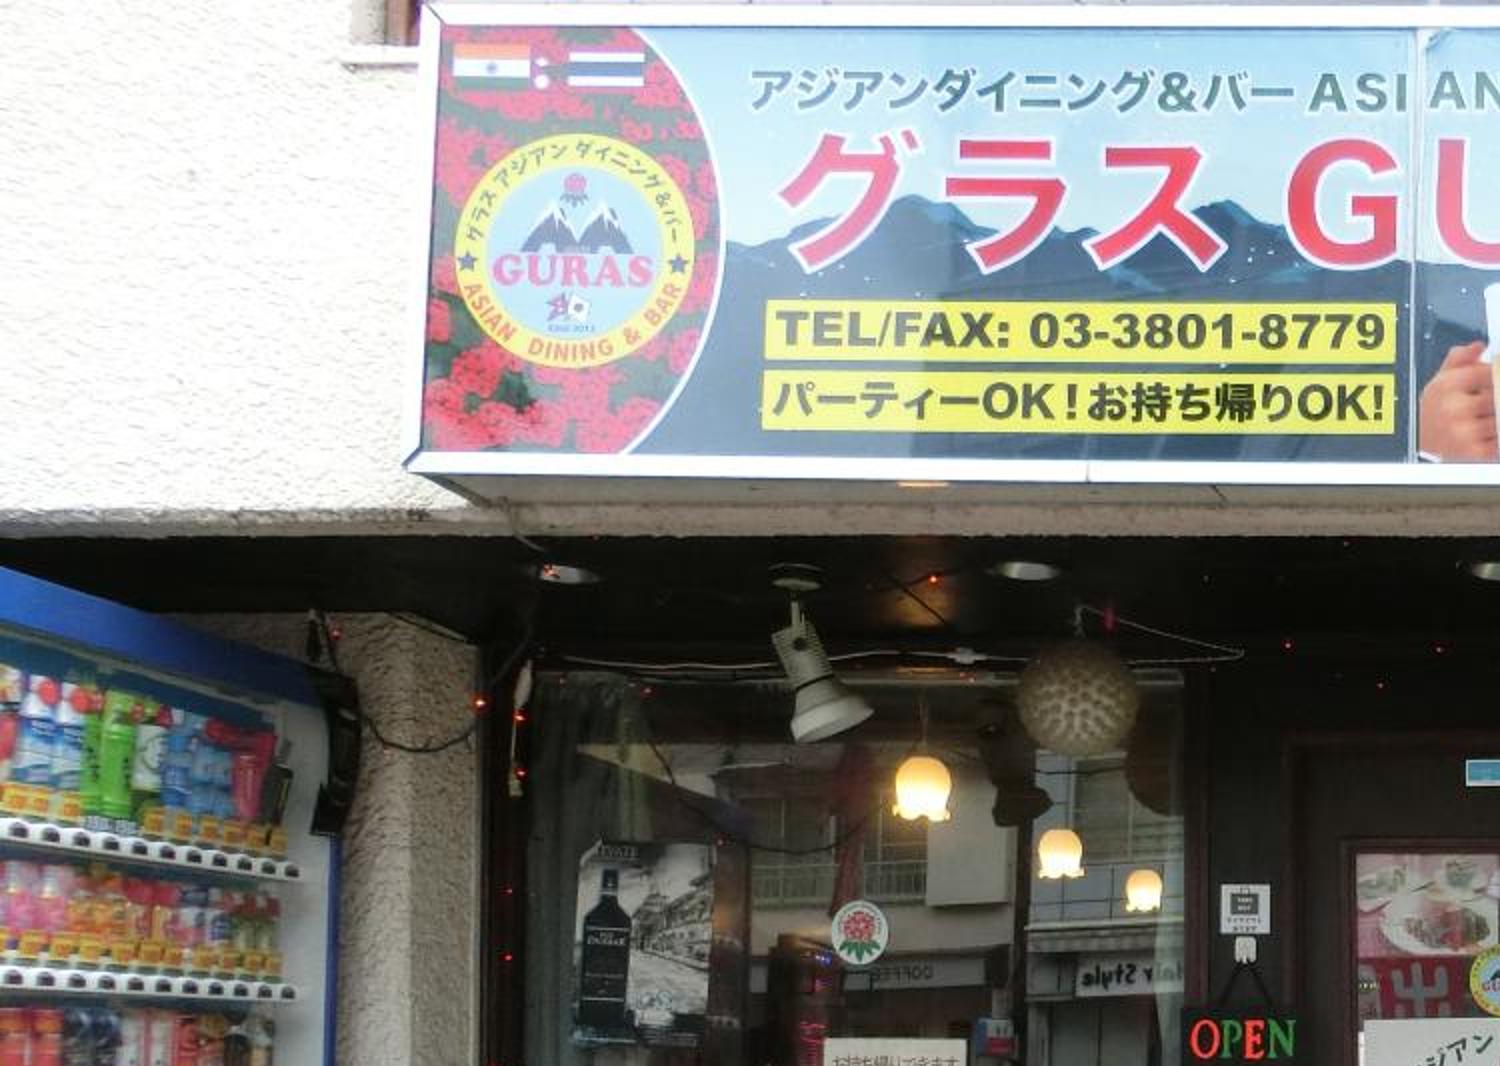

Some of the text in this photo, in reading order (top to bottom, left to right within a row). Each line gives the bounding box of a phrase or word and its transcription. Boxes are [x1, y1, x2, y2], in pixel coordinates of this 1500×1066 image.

[778, 131, 1228, 271] グラス
[491, 253, 654, 288] GURAS
[464, 283, 682, 363] ASIAN DINING & BAR
[776, 310, 1386, 350] TEL/FAX: 03-3801-8779
[1189, 1018, 1297, 1060] OPEN
